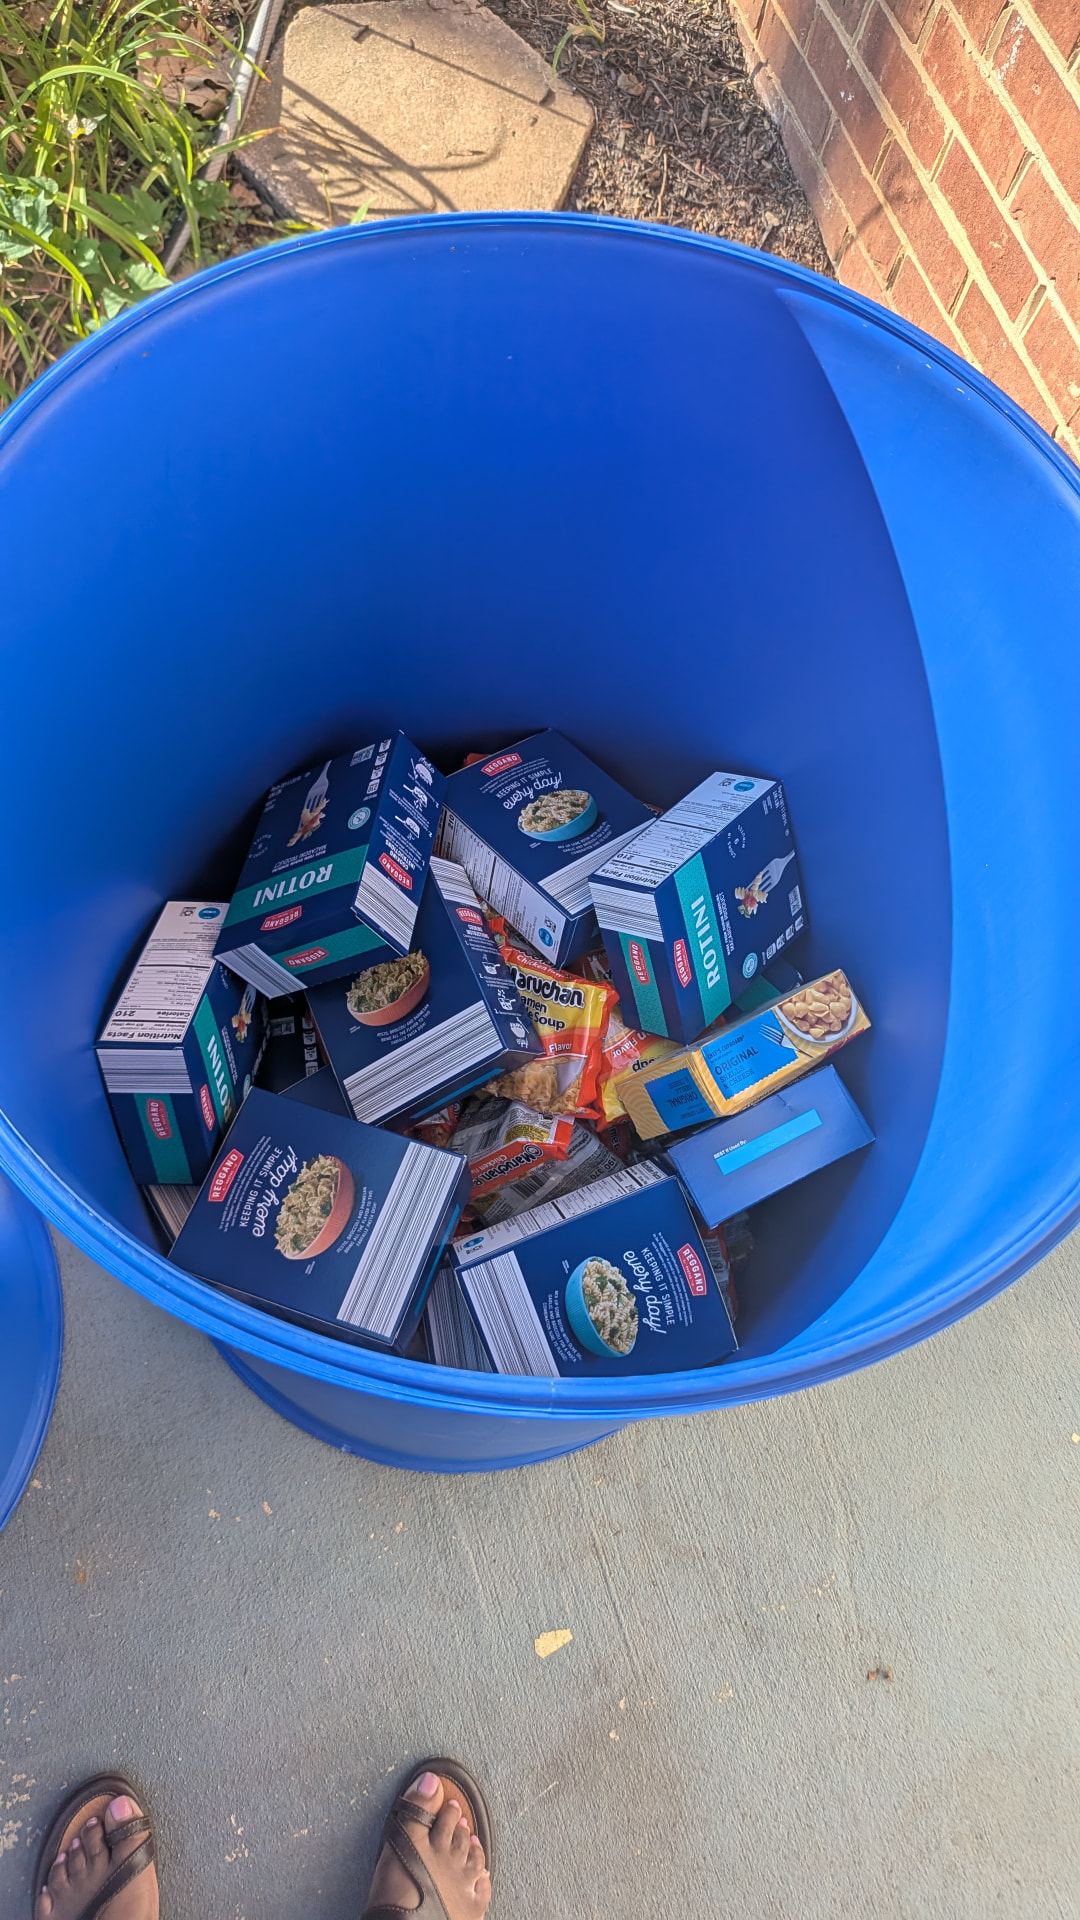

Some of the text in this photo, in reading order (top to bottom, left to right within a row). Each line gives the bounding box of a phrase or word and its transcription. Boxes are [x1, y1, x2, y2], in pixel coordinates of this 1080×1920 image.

[486, 755, 517, 774] REGGANO
[496, 767, 553, 799] KEEPING IT SIMPLE
[503, 785, 533, 810] every
[535, 772, 564, 791] day!
[253, 862, 333, 907] ROTINI
[381, 857, 410, 885] REGGANO
[601, 868, 659, 885] Nutrition Facts
[264, 909, 299, 928] REGGANO
[690, 894, 721, 989] ROTINI
[288, 949, 325, 966] REGGANO
[516, 954, 548, 972] Chicken
[631, 944, 647, 981] REGGANO
[675, 943, 690, 983] REGGANO
[521, 995, 547, 1013] amen
[137, 1031, 181, 1040] Nutrition
[534, 1011, 565, 1031] Soup
[549, 1042, 572, 1053] Flavor
[612, 1039, 638, 1058] Flavor
[714, 1045, 759, 1076] ORIGINAL
[149, 1101, 166, 1137] REGGANO
[212, 1153, 238, 1197] REGGANO
[479, 1153, 508, 1171] Chicken
[481, 1152, 536, 1181] Maruchan
[240, 1147, 283, 1227] KEEPING IT SIMPLE
[254, 1145, 298, 1236] every day!
[682, 1248, 704, 1292] REGGANO
[623, 1251, 667, 1334] every day!
[641, 1247, 676, 1326] KEEPING IT SIMPLE
